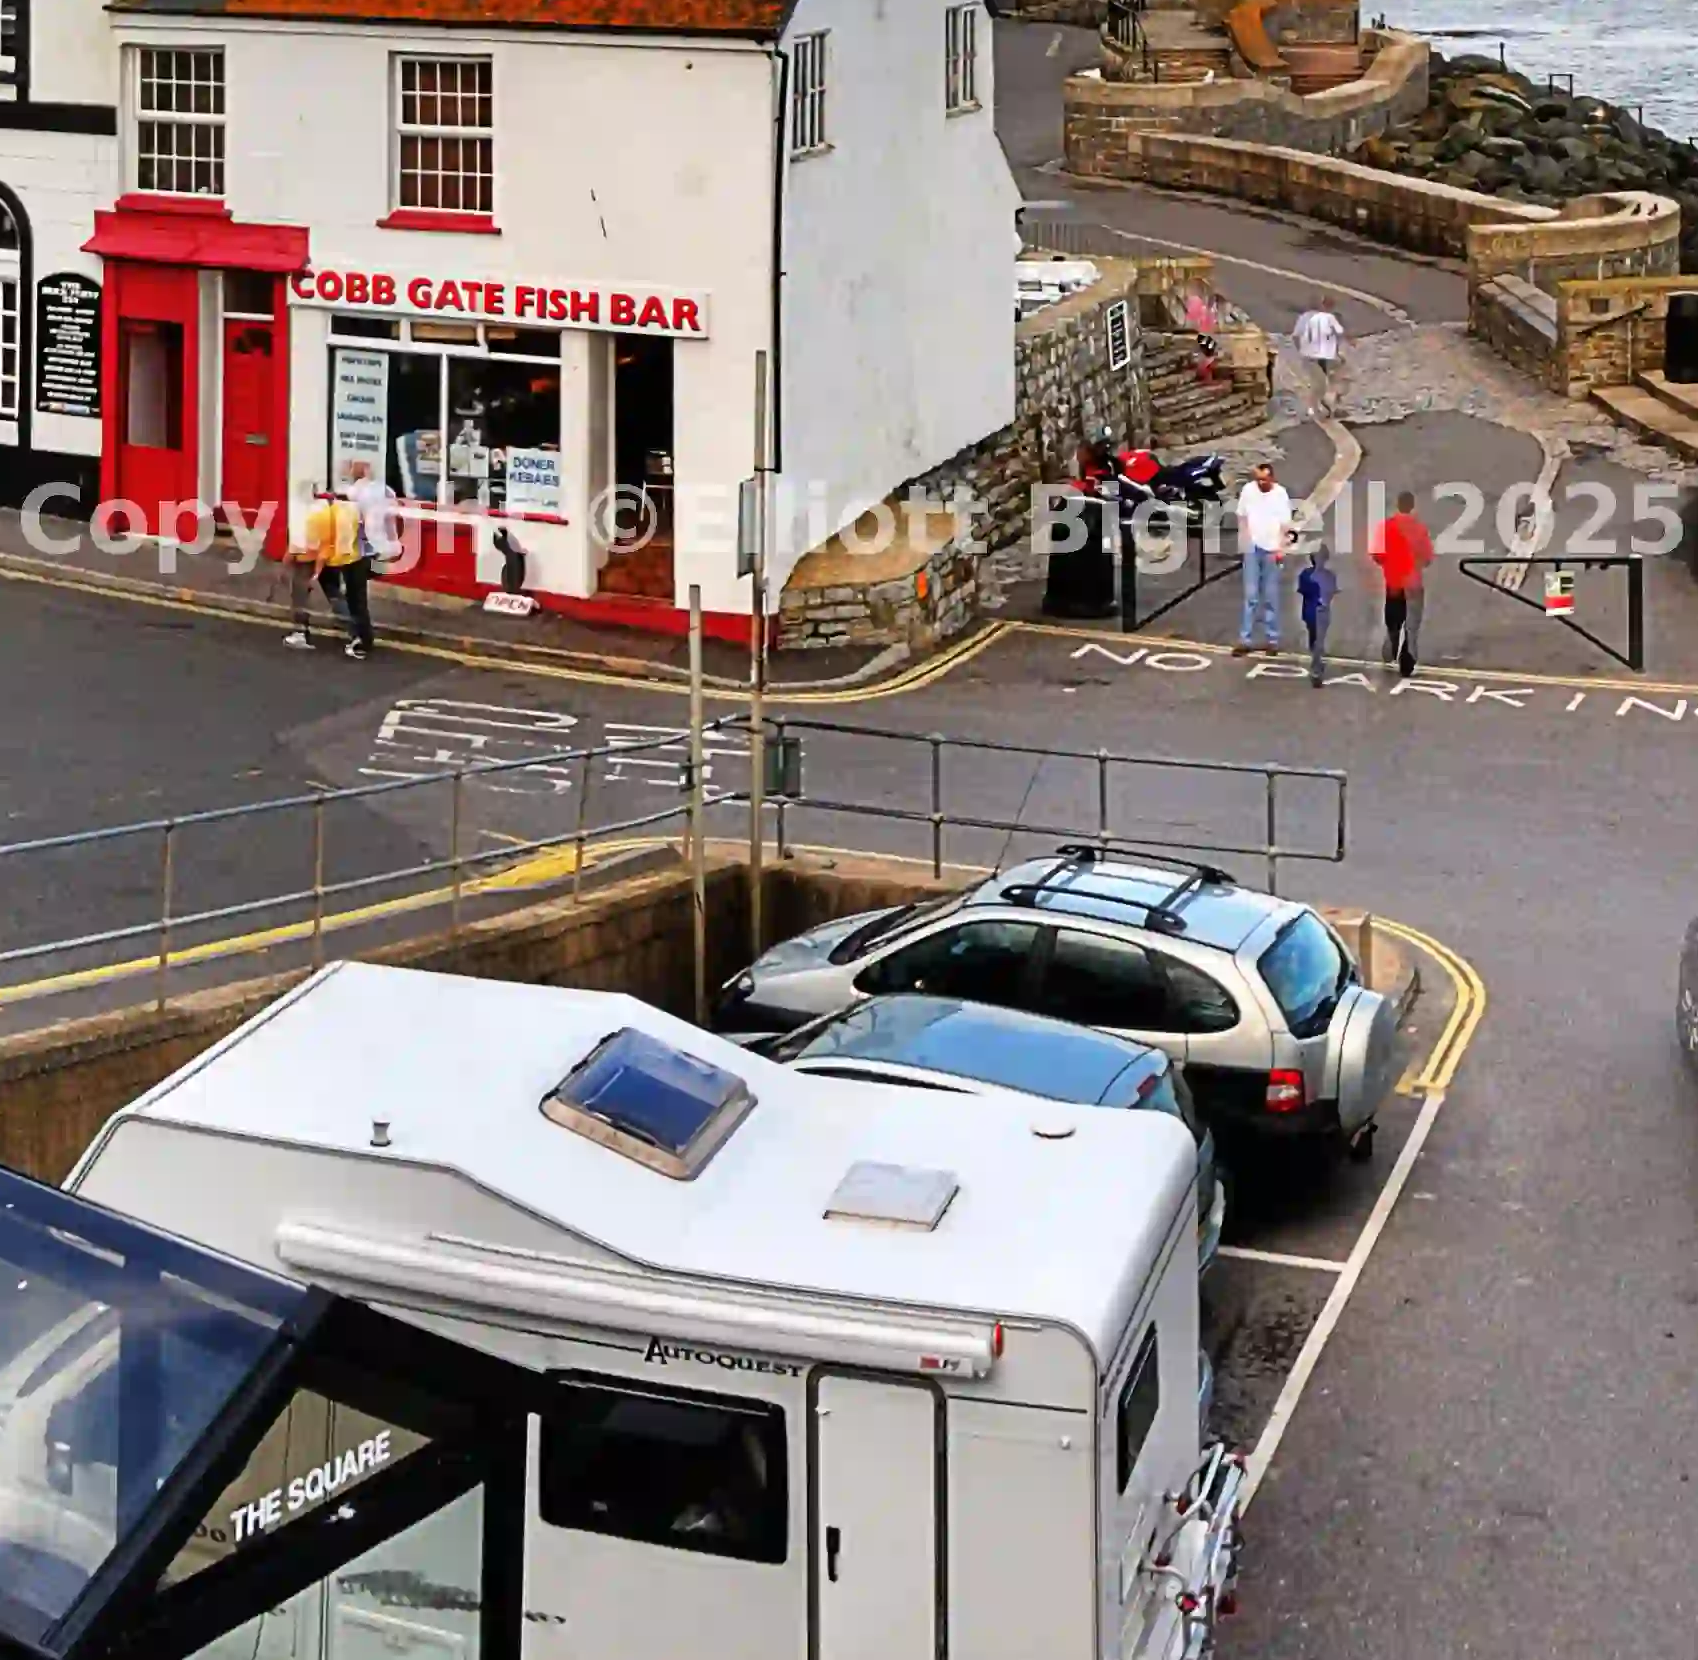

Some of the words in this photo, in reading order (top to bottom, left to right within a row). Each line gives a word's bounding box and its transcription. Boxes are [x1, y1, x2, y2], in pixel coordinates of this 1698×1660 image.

[291, 269, 397, 305] COBB
[407, 277, 505, 315] GATE
[515, 285, 600, 325] FISH
[609, 294, 701, 332] BAR
[513, 456, 555, 471] DONER
[1070, 642, 1213, 672] NO
[230, 1488, 282, 1541] THE
[287, 1429, 391, 1512] SQUARE
